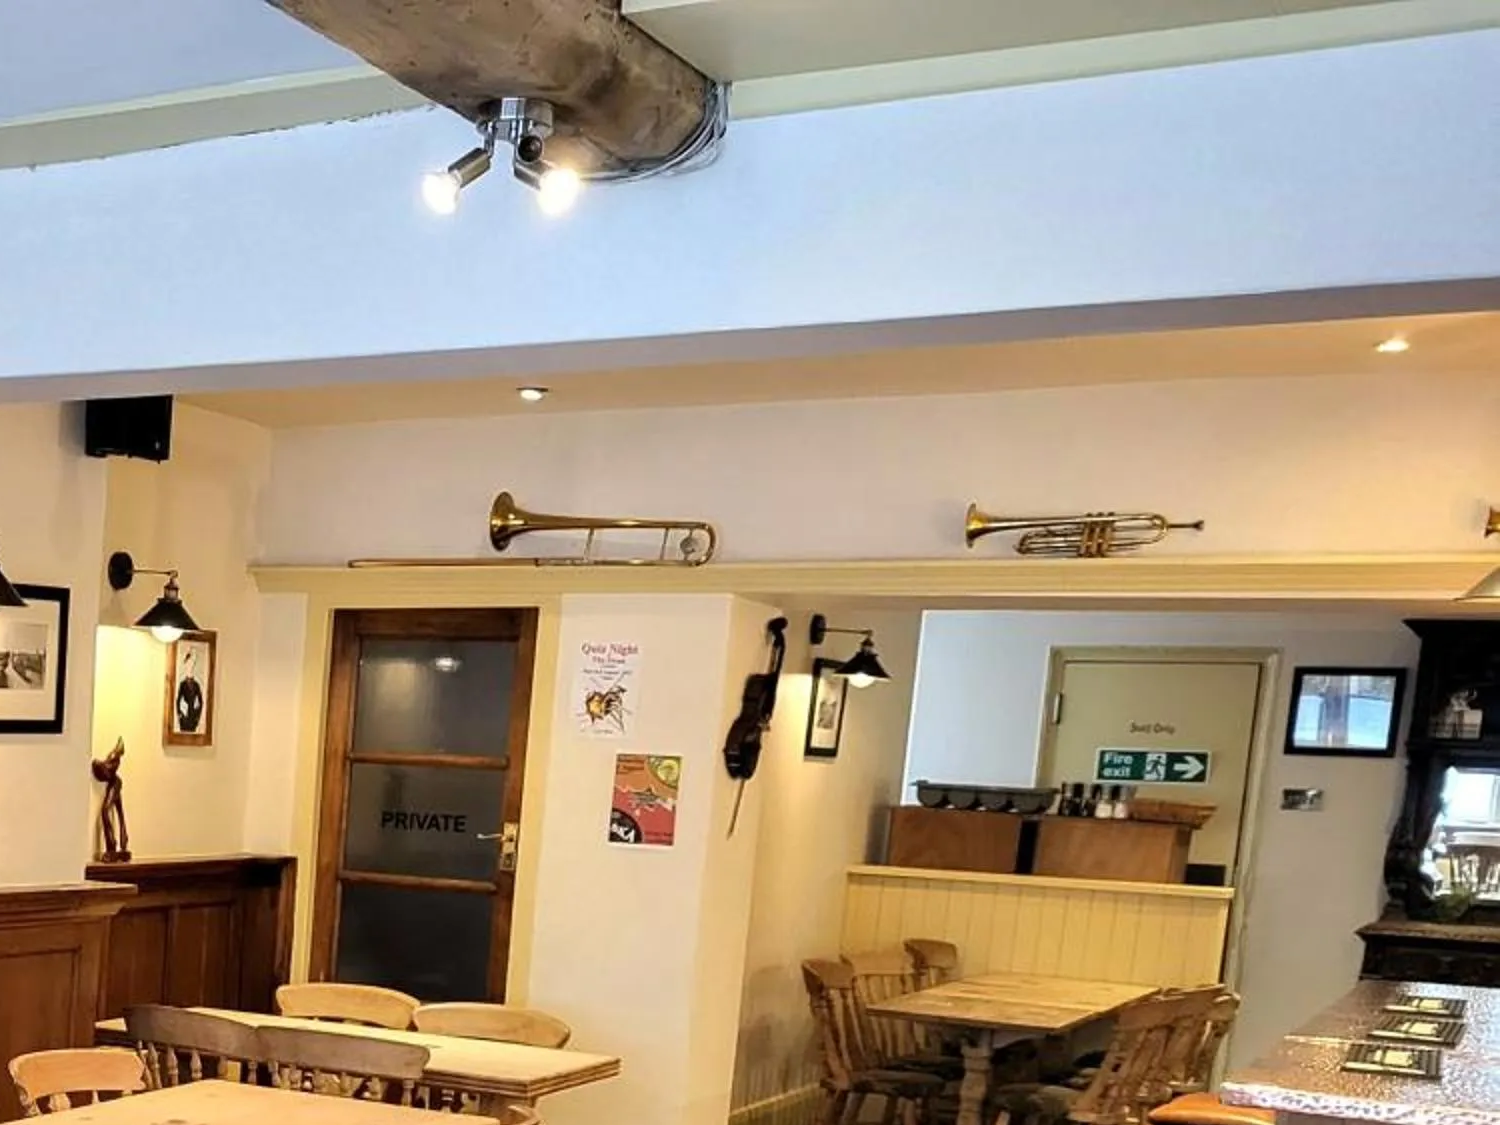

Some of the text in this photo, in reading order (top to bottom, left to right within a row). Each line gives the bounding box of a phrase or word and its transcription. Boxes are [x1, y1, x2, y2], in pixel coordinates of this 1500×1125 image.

[607, 643, 638, 656] Night
[1102, 752, 1133, 765] Fire
[1102, 766, 1131, 777] exit
[381, 811, 467, 833] PRIVATE
